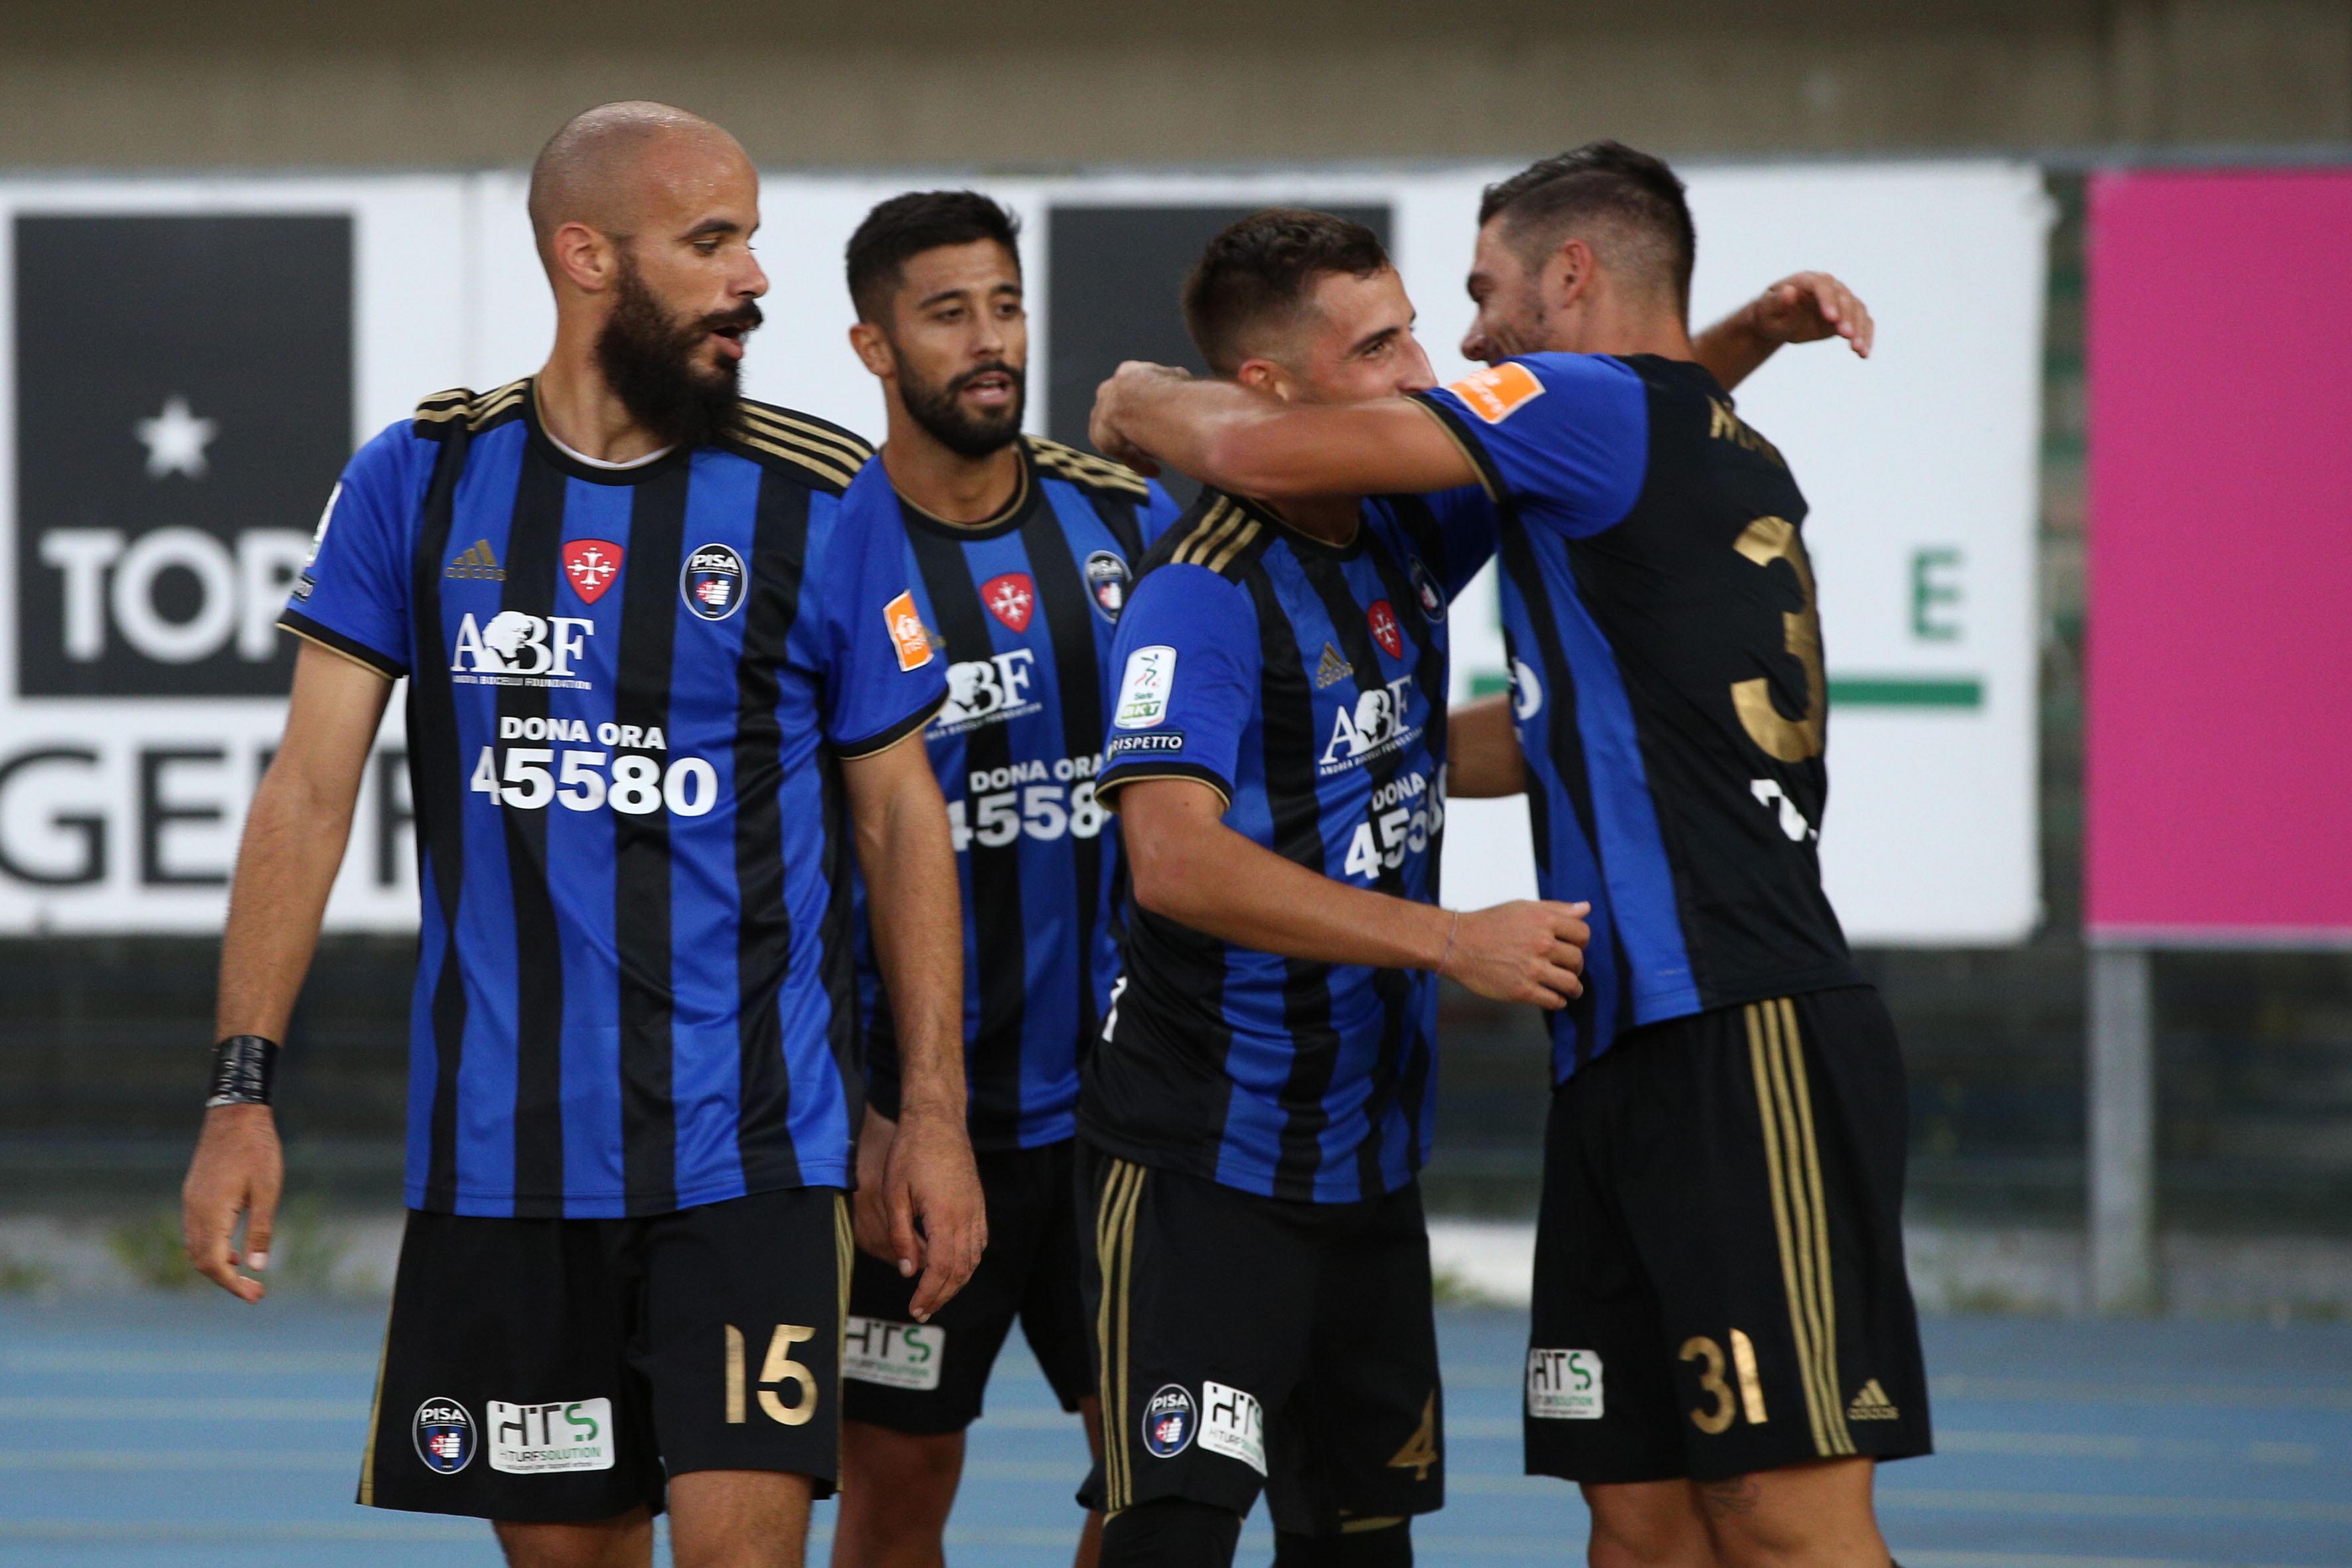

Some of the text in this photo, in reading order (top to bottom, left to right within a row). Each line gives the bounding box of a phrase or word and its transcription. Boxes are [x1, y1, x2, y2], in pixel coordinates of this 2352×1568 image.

[446, 566, 507, 582] adidas
[691, 554, 740, 570] PISA
[450, 610, 594, 676] ABF
[501, 716, 667, 749] DONA ORA
[1319, 674, 1412, 765] ABF
[1111, 735, 1183, 751] RISPETTO
[470, 745, 719, 817] 45580
[970, 759, 1050, 794] DONA
[1372, 772, 1427, 812] DONA
[724, 1323, 819, 1426] 15
[1533, 1352, 1592, 1391] HTS
[1678, 1327, 1768, 1435] 31
[421, 1407, 466, 1422] PISA
[1151, 1393, 1190, 1412] PISA
[498, 1403, 599, 1447] HTS
